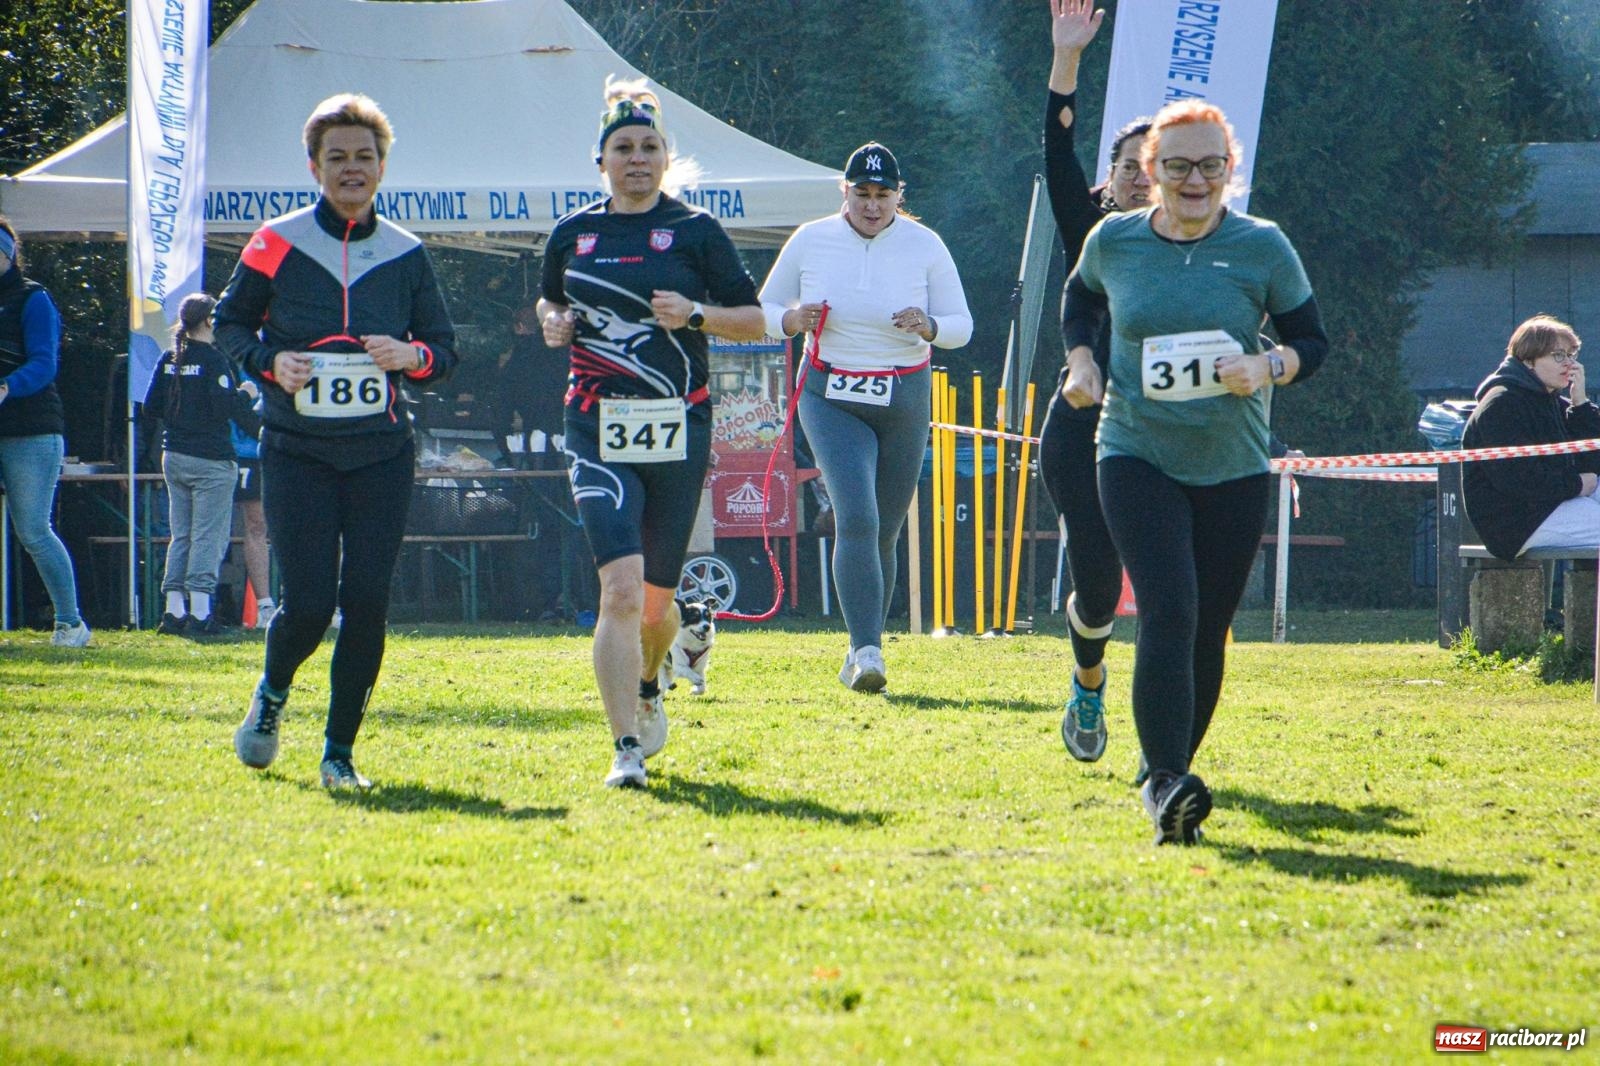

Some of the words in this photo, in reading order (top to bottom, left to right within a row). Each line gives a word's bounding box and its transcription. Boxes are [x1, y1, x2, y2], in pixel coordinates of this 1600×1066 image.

[376, 191, 468, 219] AKTYWNI
[489, 191, 529, 219] DLA
[303, 376, 381, 405] 186
[831, 374, 888, 397] 325
[606, 422, 681, 450] 347
